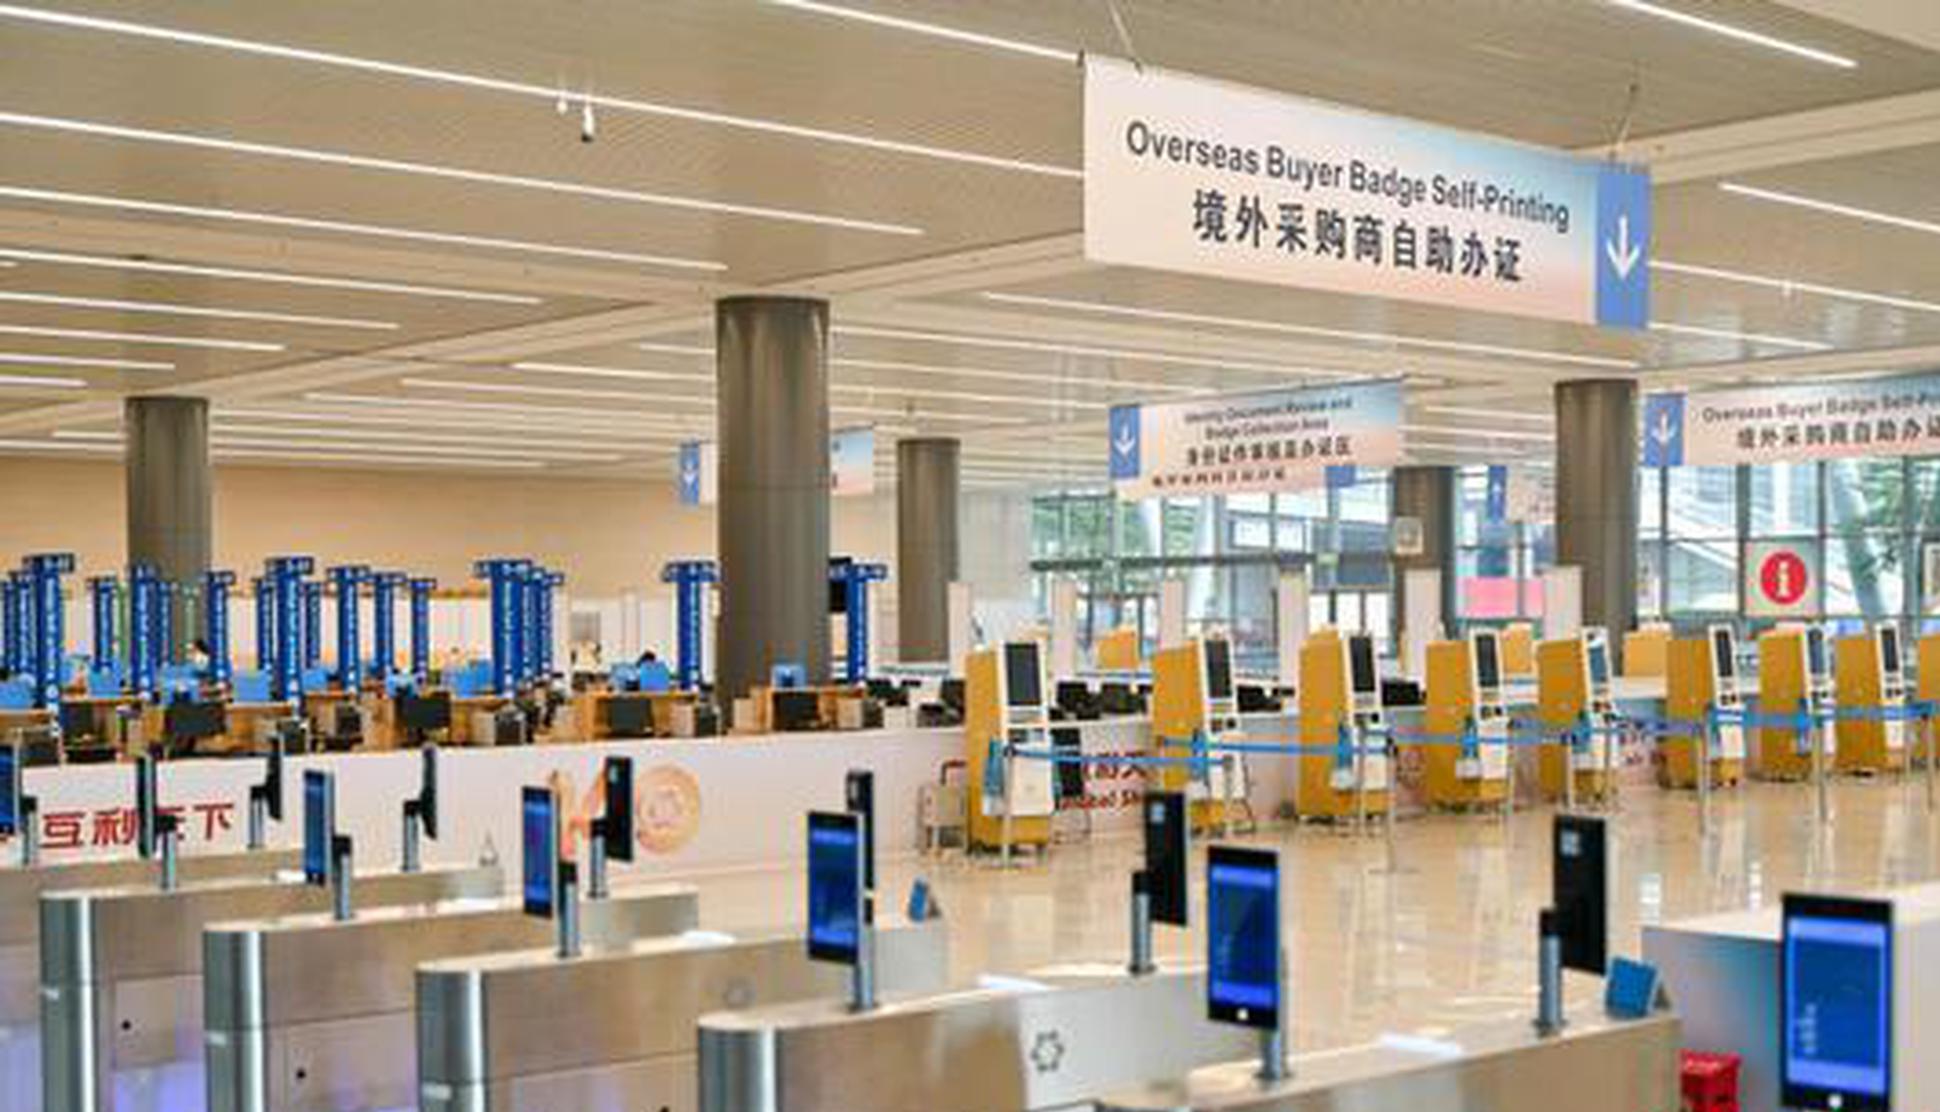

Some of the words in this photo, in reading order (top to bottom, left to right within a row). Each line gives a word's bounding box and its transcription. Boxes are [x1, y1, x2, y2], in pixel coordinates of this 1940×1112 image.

[1126, 120, 1260, 176] Overseas
[1267, 145, 1343, 191] Buyer
[1349, 159, 1427, 208] Badge
[1432, 174, 1570, 233] Self-Printing
[1193, 189, 1522, 281] 境外采购商自助办证
